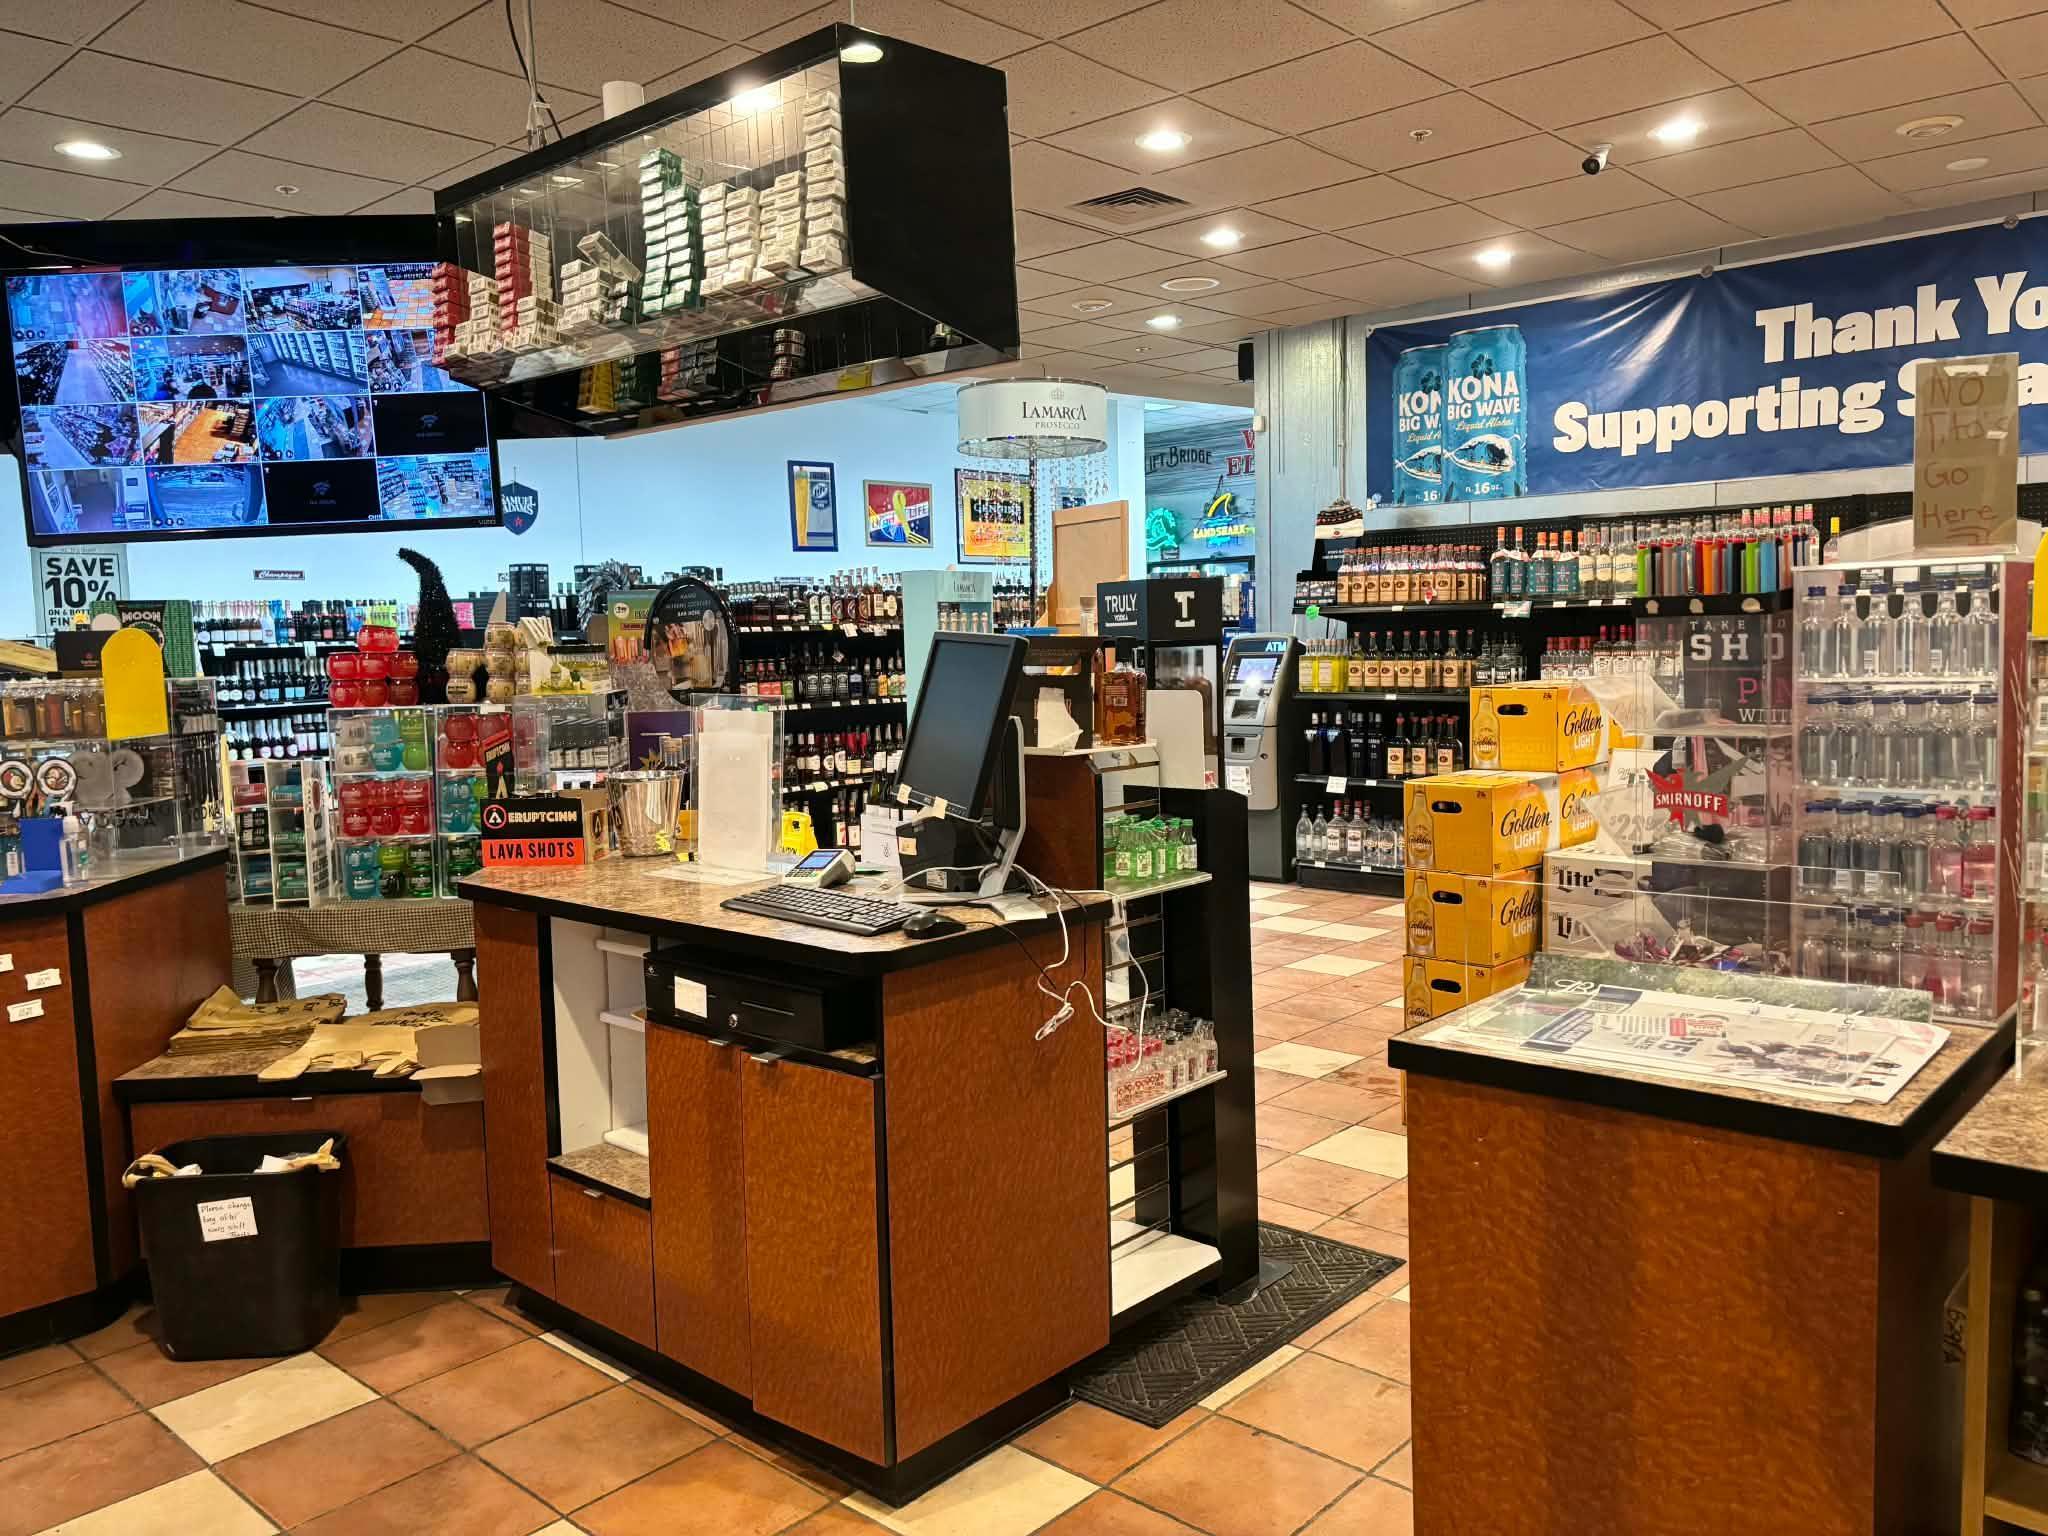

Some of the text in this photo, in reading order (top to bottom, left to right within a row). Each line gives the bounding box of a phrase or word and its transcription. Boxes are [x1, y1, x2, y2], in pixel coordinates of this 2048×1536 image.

[1756, 283, 1960, 364] Thank
[1447, 371, 1520, 404] KONA
[1926, 366, 1985, 408] NO
[1447, 397, 1521, 420] BIG WAVE
[1553, 376, 1886, 457] Supporting
[1035, 421, 1081, 430] PROSECCO
[1399, 417, 1421, 433] BIG
[1456, 421, 1484, 433] Liquid
[1924, 462, 1969, 489] Go
[1423, 490, 1438, 502] 16
[1474, 481, 1490, 495] 16
[1921, 502, 1998, 529] Here
[46, 557, 115, 577] SAVE
[45, 577, 117, 609] 10%
[1104, 594, 1138, 613] TRULY
[1689, 620, 1746, 631] TAKE
[1264, 641, 1288, 652] ATM
[1563, 706, 1605, 738] Golden
[1573, 733, 1596, 750] LIGHT
[1655, 792, 1723, 812] SMIRNOFF
[508, 811, 578, 824] ERUPTCINN
[1500, 803, 1553, 838] Golden
[1514, 830, 1543, 849] LIGHT
[488, 841, 576, 860] LAVA SHOTS
[1557, 869, 1594, 889] Lite
